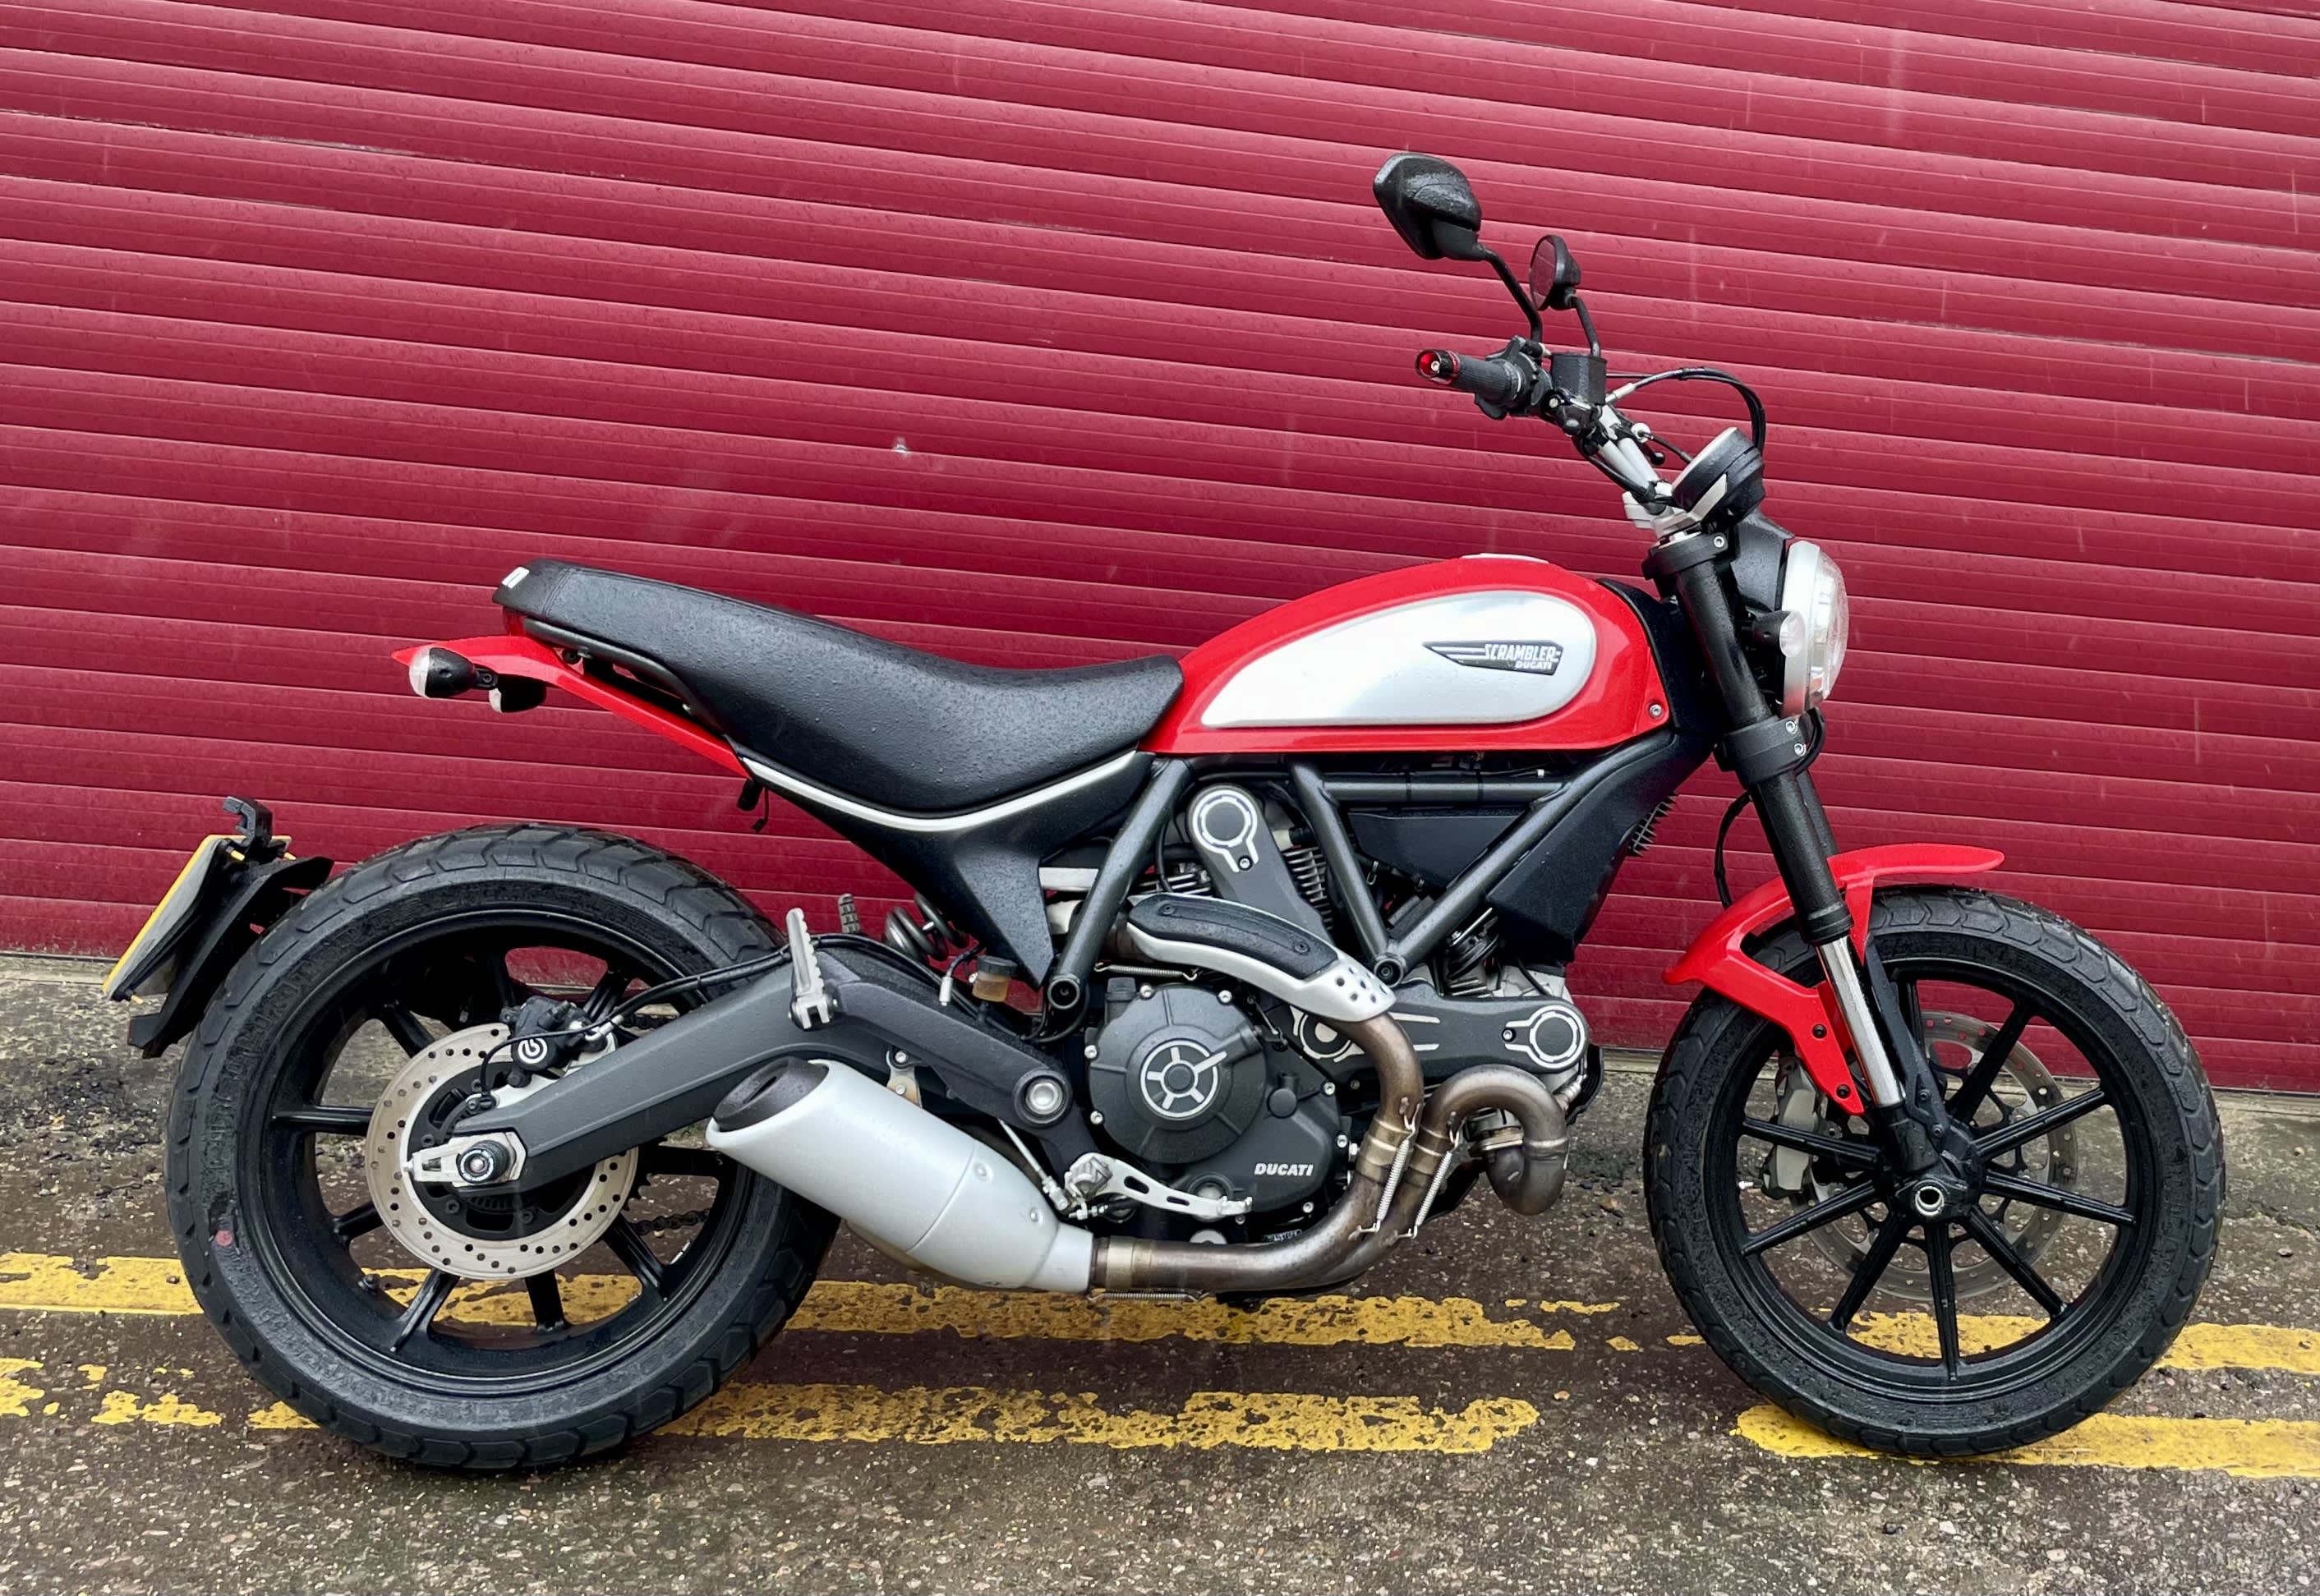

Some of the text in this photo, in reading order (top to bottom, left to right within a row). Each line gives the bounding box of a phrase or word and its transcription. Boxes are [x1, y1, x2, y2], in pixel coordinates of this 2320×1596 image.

[1484, 644, 1558, 662] SCRAMBLER
[1515, 660, 1552, 670] DUCATI
[1254, 1162, 1314, 1176] DUCATI
